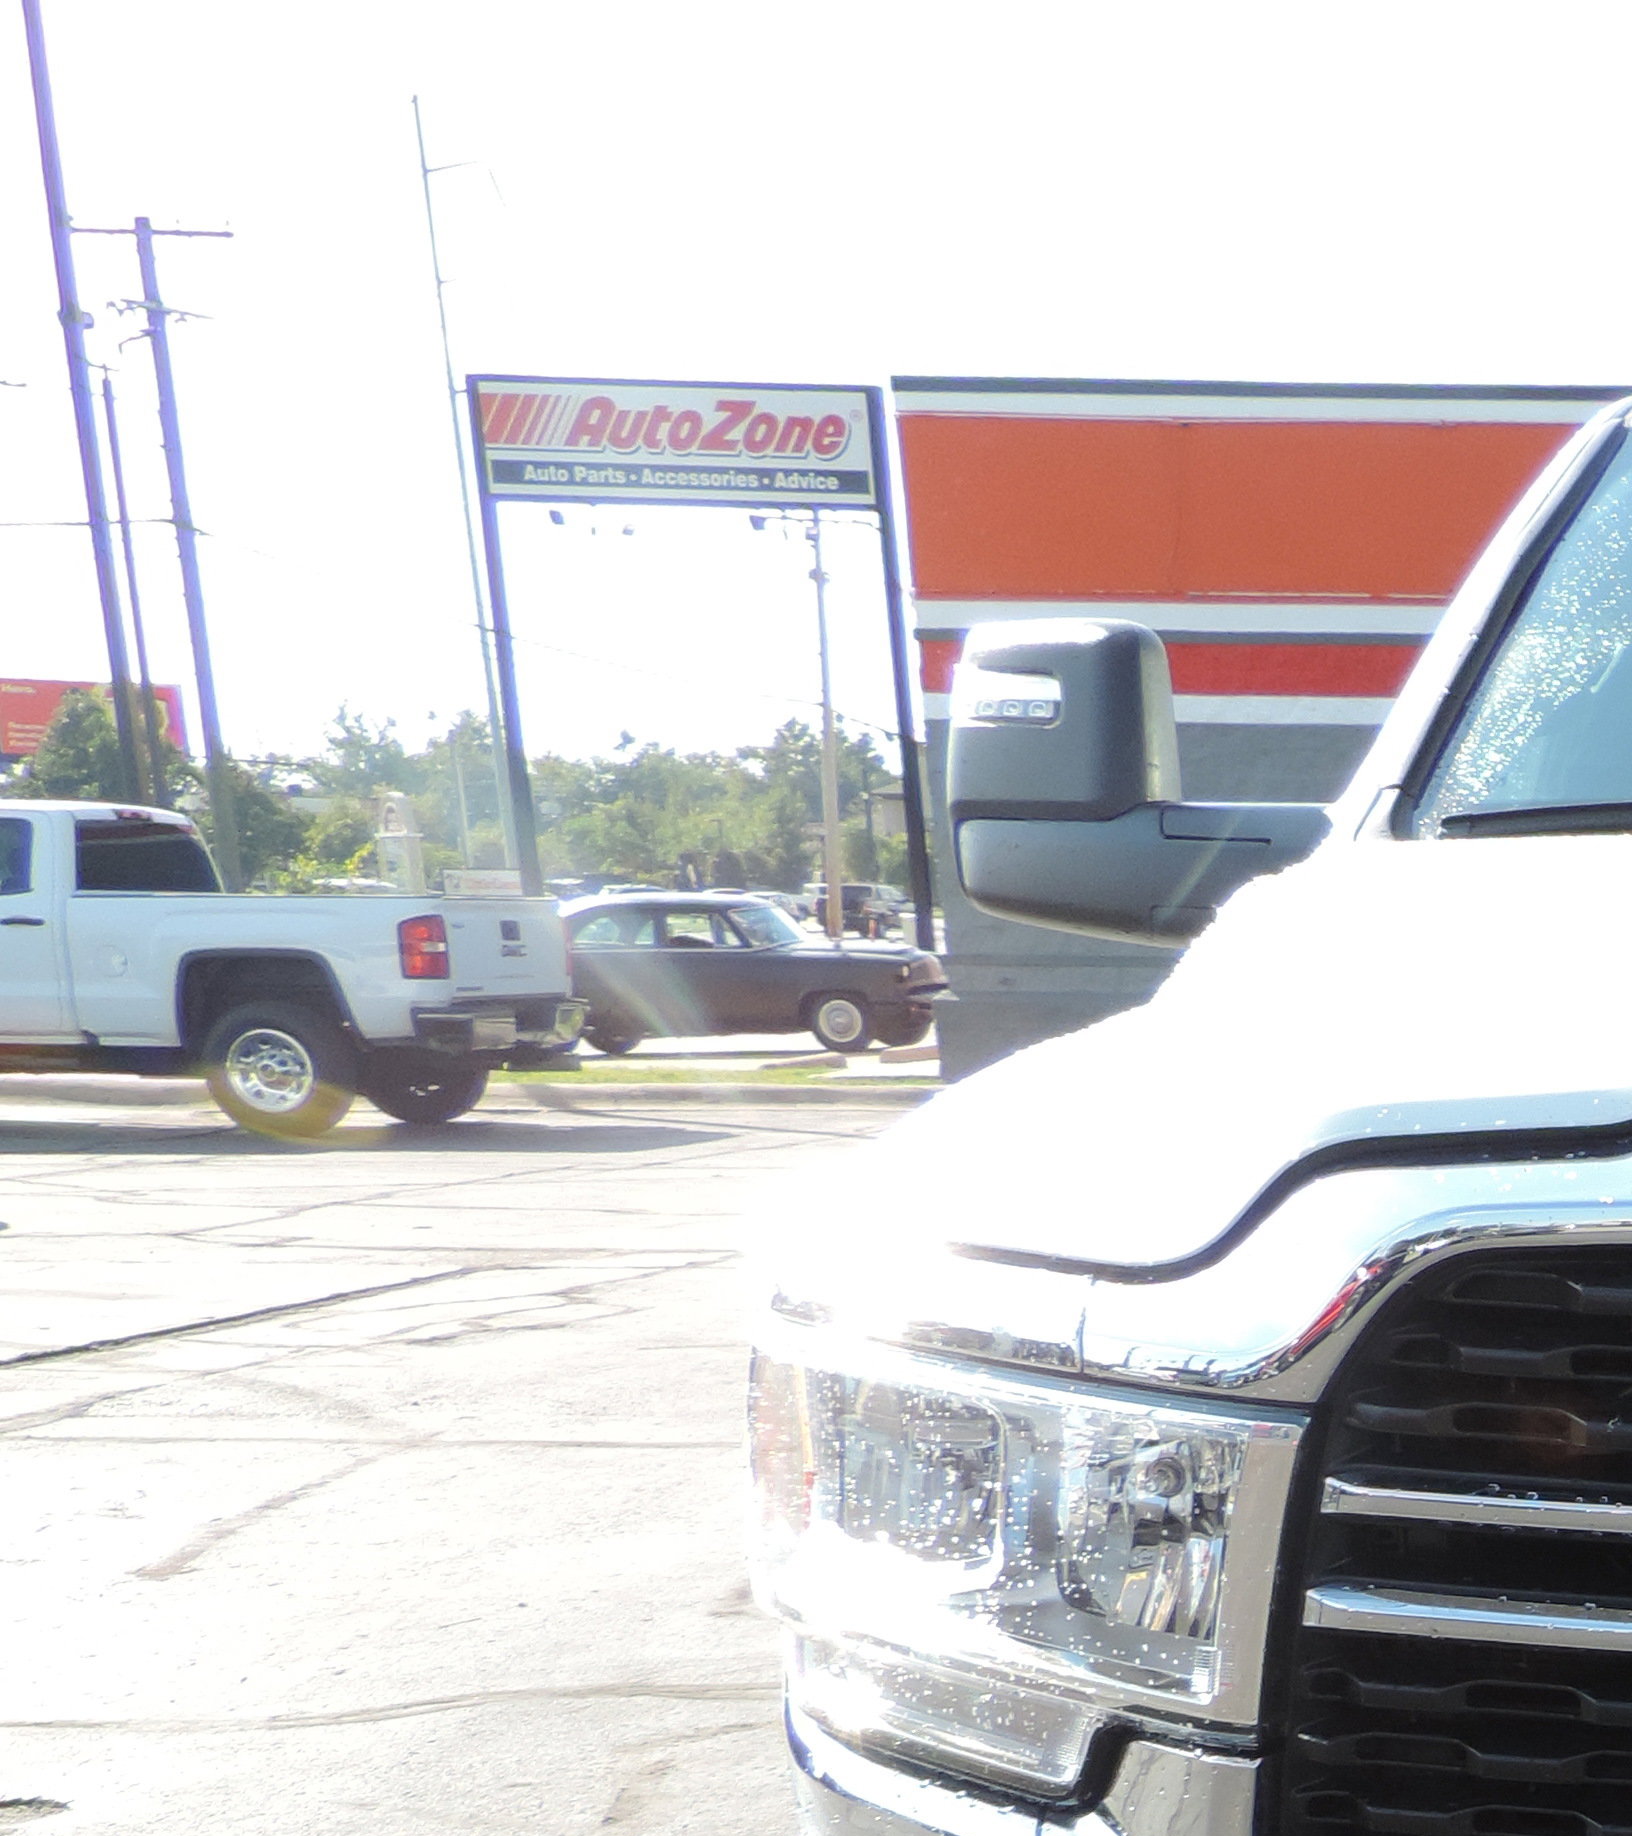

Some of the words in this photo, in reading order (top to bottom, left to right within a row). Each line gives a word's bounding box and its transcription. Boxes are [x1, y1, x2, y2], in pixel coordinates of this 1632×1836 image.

[564, 395, 848, 458] AutoZone
[523, 463, 569, 482] Auto
[574, 466, 626, 485] Parts
[641, 470, 758, 490] Accessories
[775, 471, 839, 491] Advice
